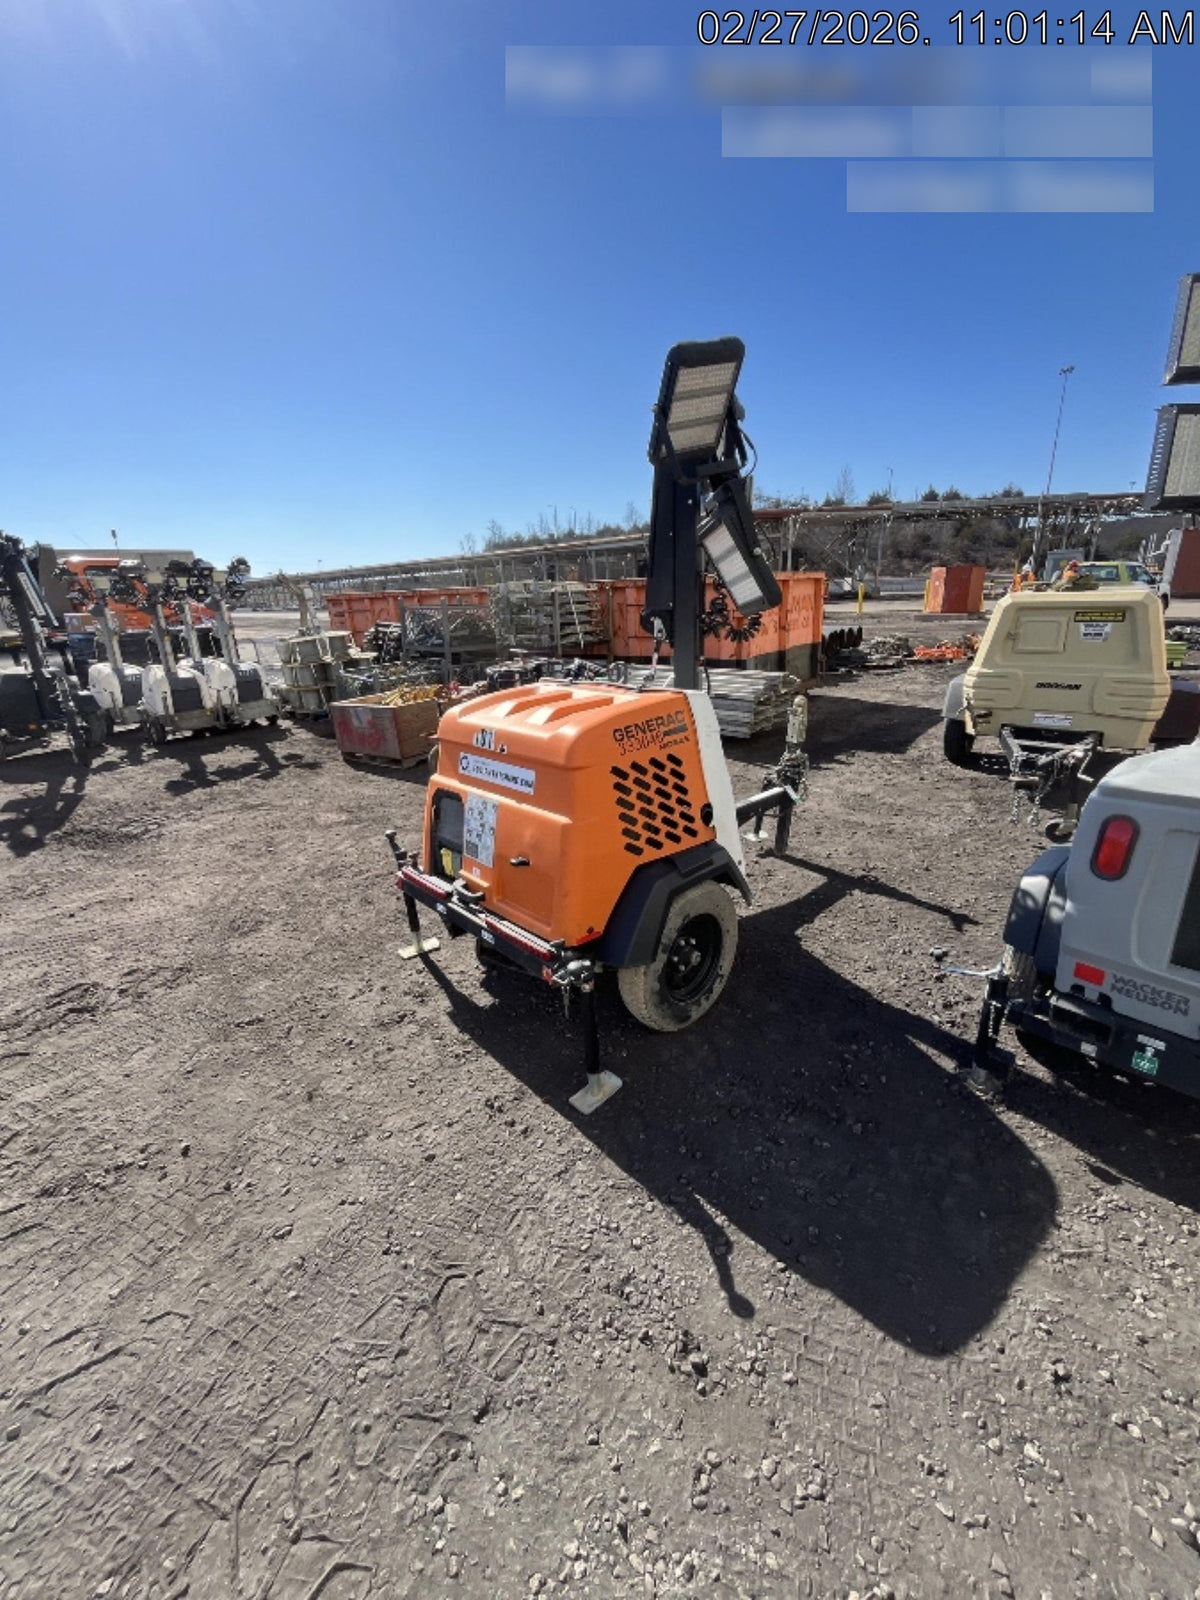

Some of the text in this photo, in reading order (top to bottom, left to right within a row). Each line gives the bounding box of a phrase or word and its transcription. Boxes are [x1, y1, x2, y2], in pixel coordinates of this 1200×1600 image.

[613, 710, 686, 742] GENERAC
[1110, 983, 1190, 1017] NEUSON
[1111, 973, 1191, 1006] WACKER
